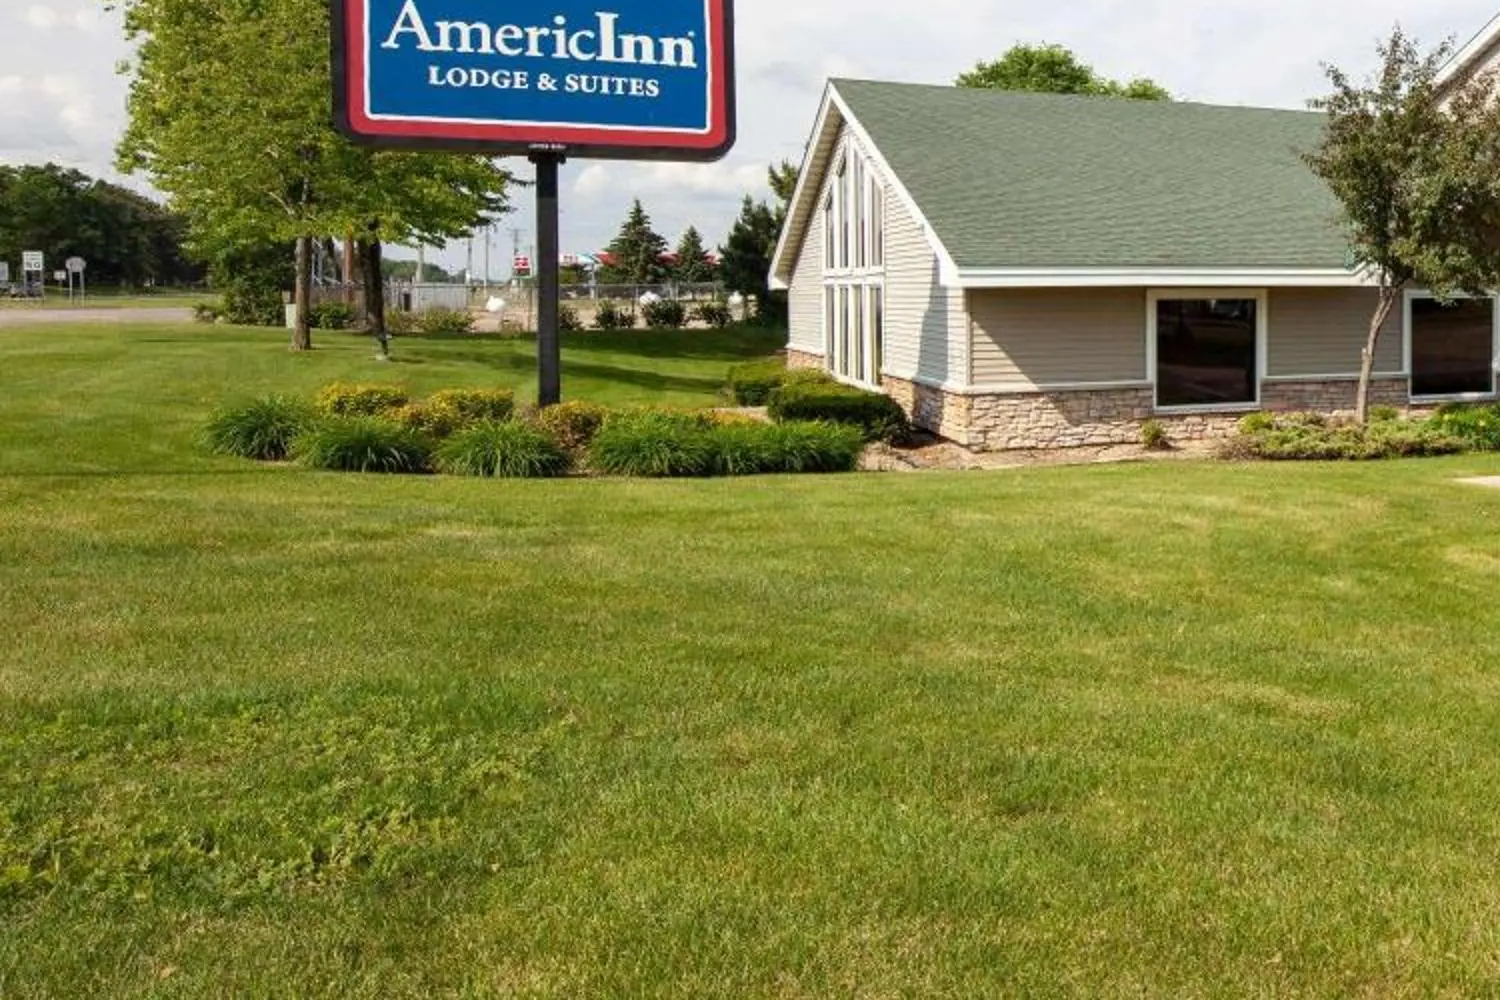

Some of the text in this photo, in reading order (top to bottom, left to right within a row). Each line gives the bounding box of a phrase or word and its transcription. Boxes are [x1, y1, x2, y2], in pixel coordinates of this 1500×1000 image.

[429, 65, 659, 97] LODGE & SUITES
